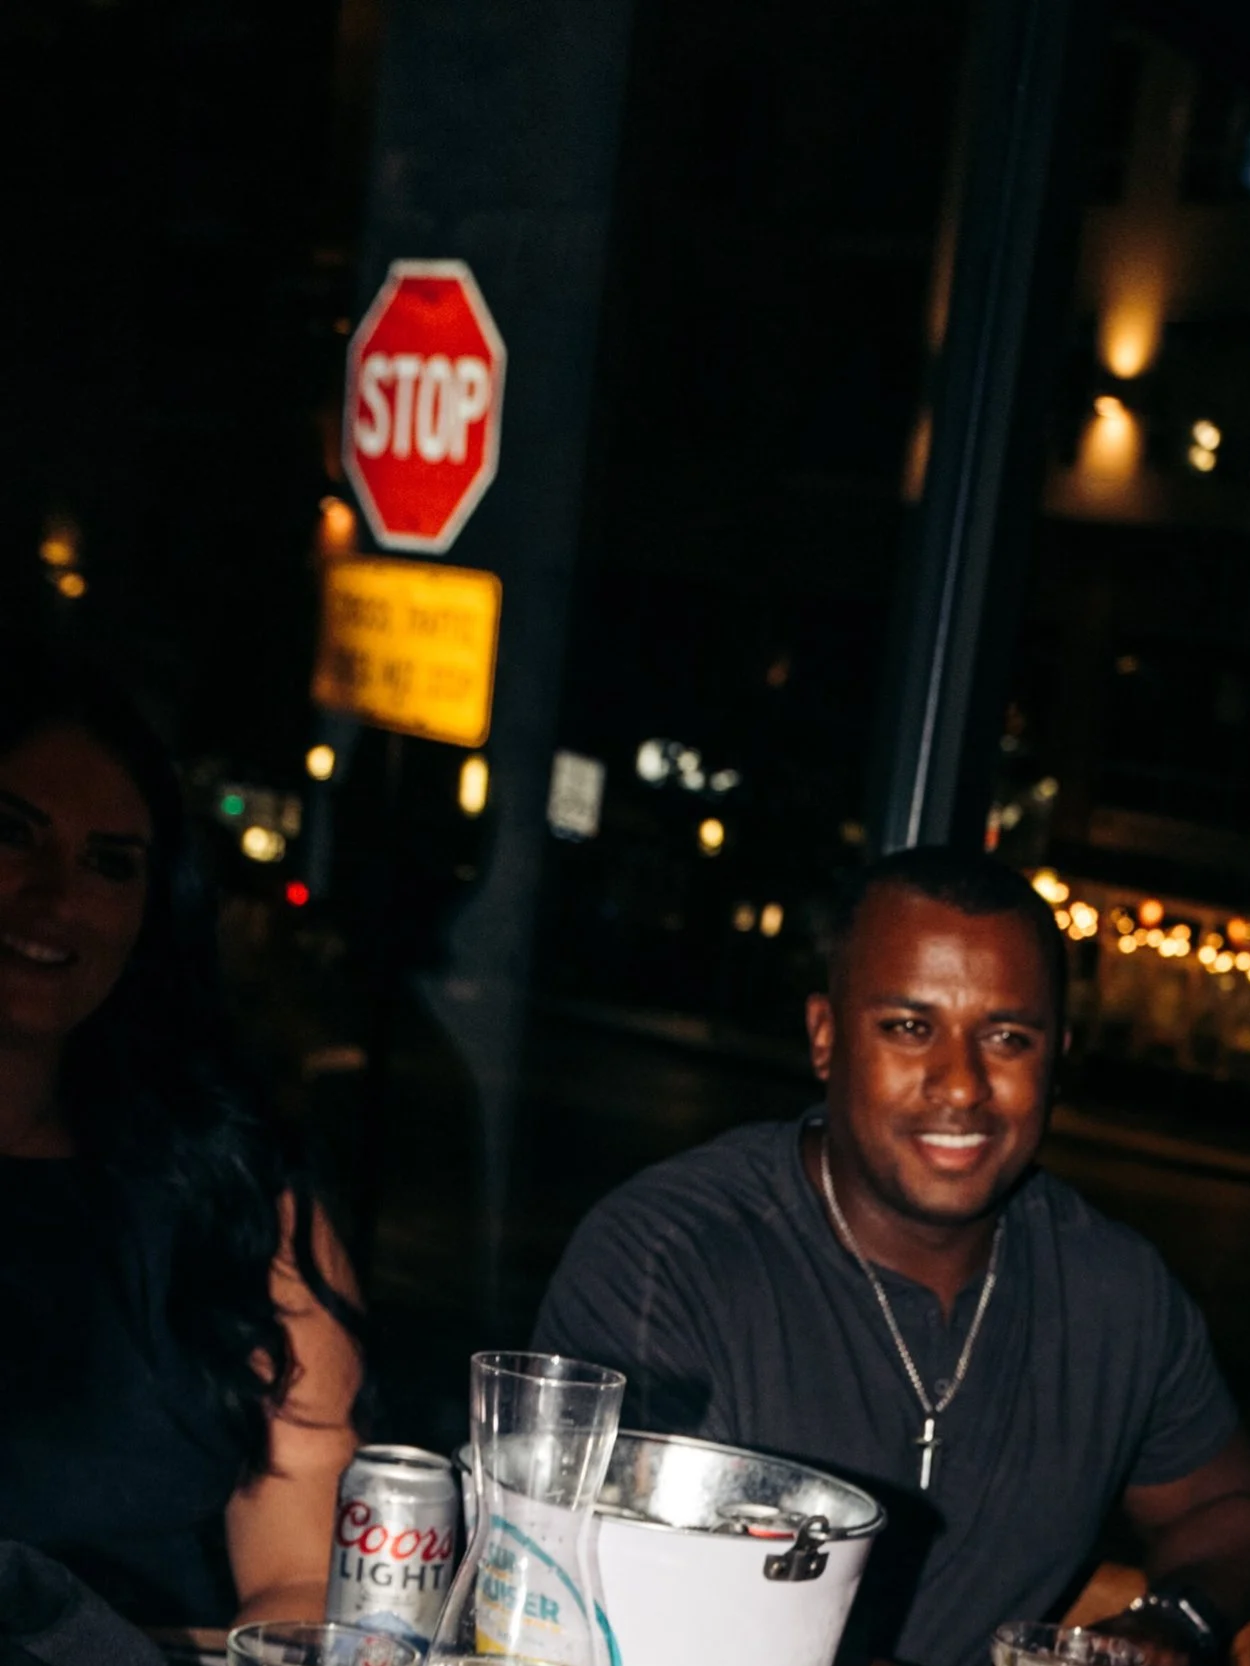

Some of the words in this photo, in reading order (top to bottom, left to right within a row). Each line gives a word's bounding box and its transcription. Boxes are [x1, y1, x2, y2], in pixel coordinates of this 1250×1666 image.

[355, 353, 489, 464] STOP
[336, 1500, 453, 1562] Coors
[340, 1550, 446, 1591] LIGHT
